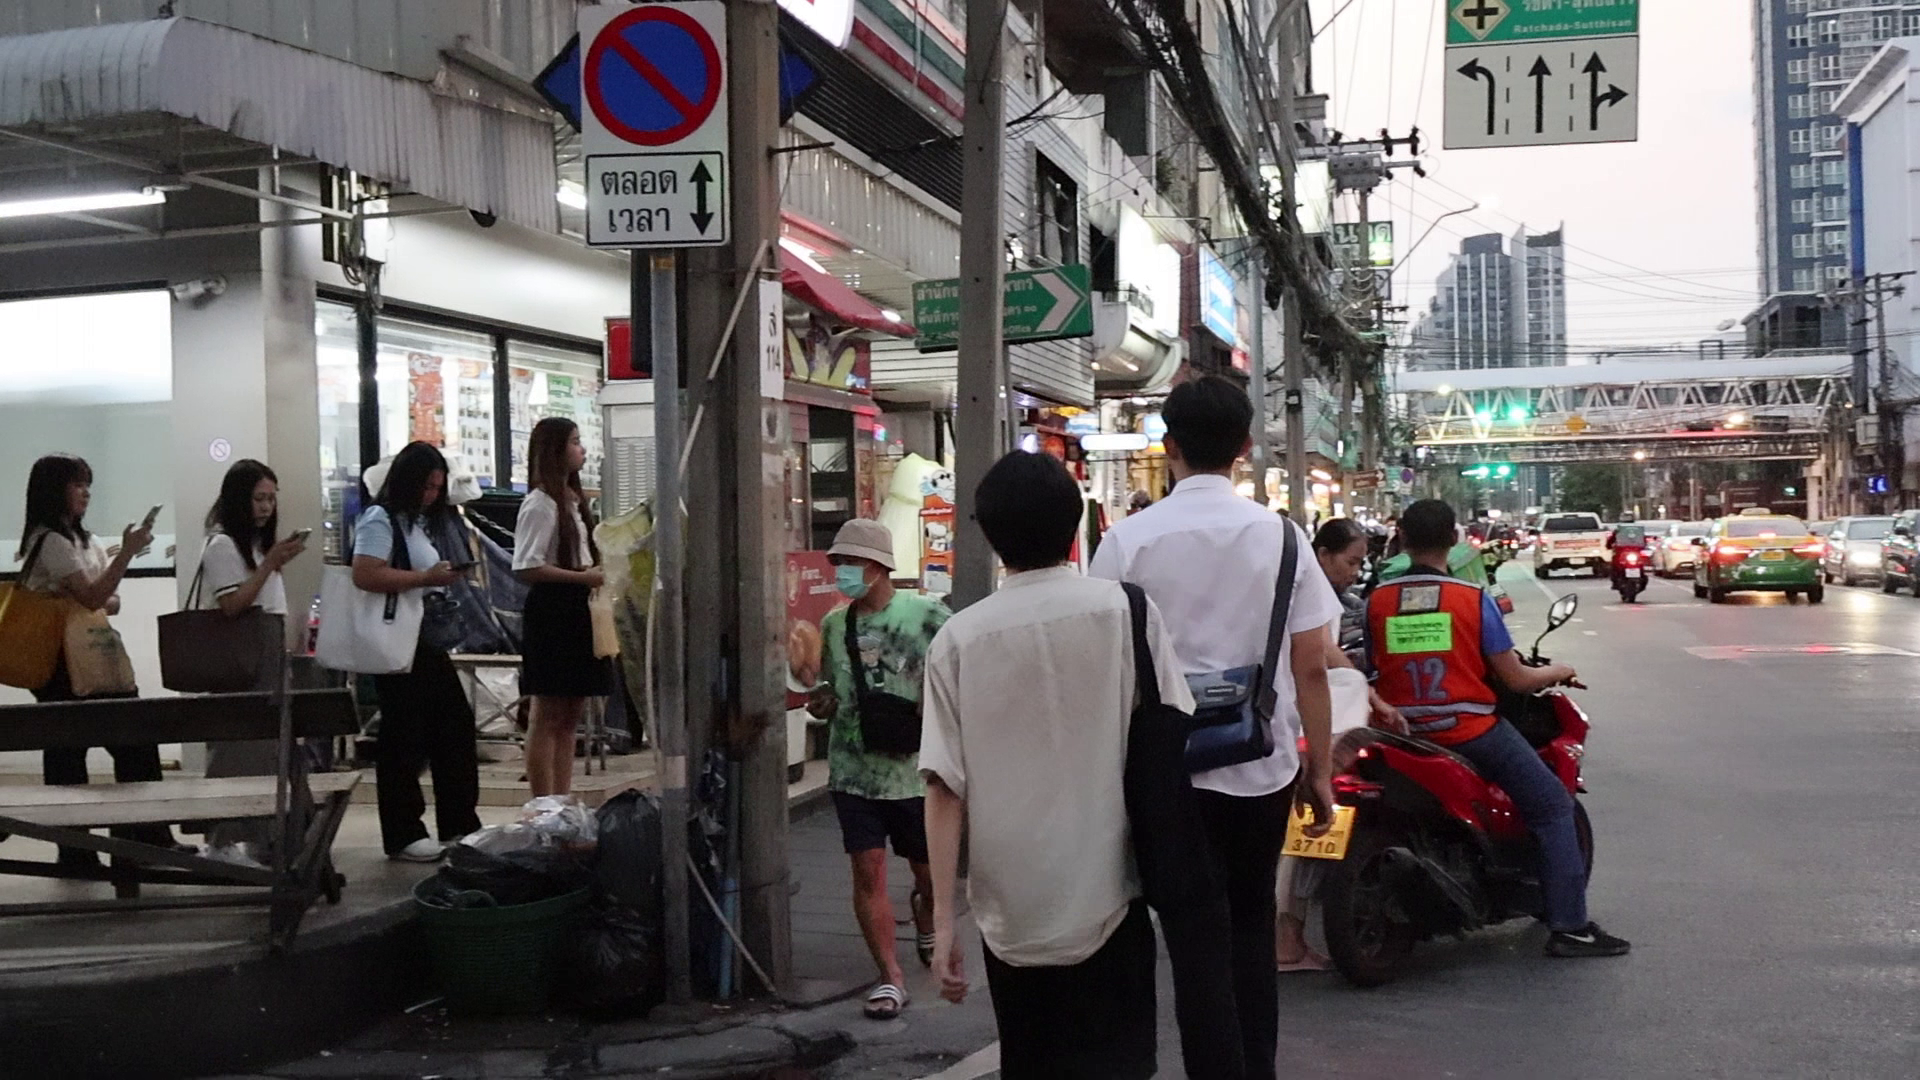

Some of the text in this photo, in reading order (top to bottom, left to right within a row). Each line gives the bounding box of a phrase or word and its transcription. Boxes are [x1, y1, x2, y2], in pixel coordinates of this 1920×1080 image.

[1514, 19, 1632, 33] Ratchada-Sutthisan
[601, 168, 678, 196] ตลอด
[608, 206, 671, 233] เวลา
[1404, 657, 1447, 699] 12
[1292, 839, 1336, 854] 3710
